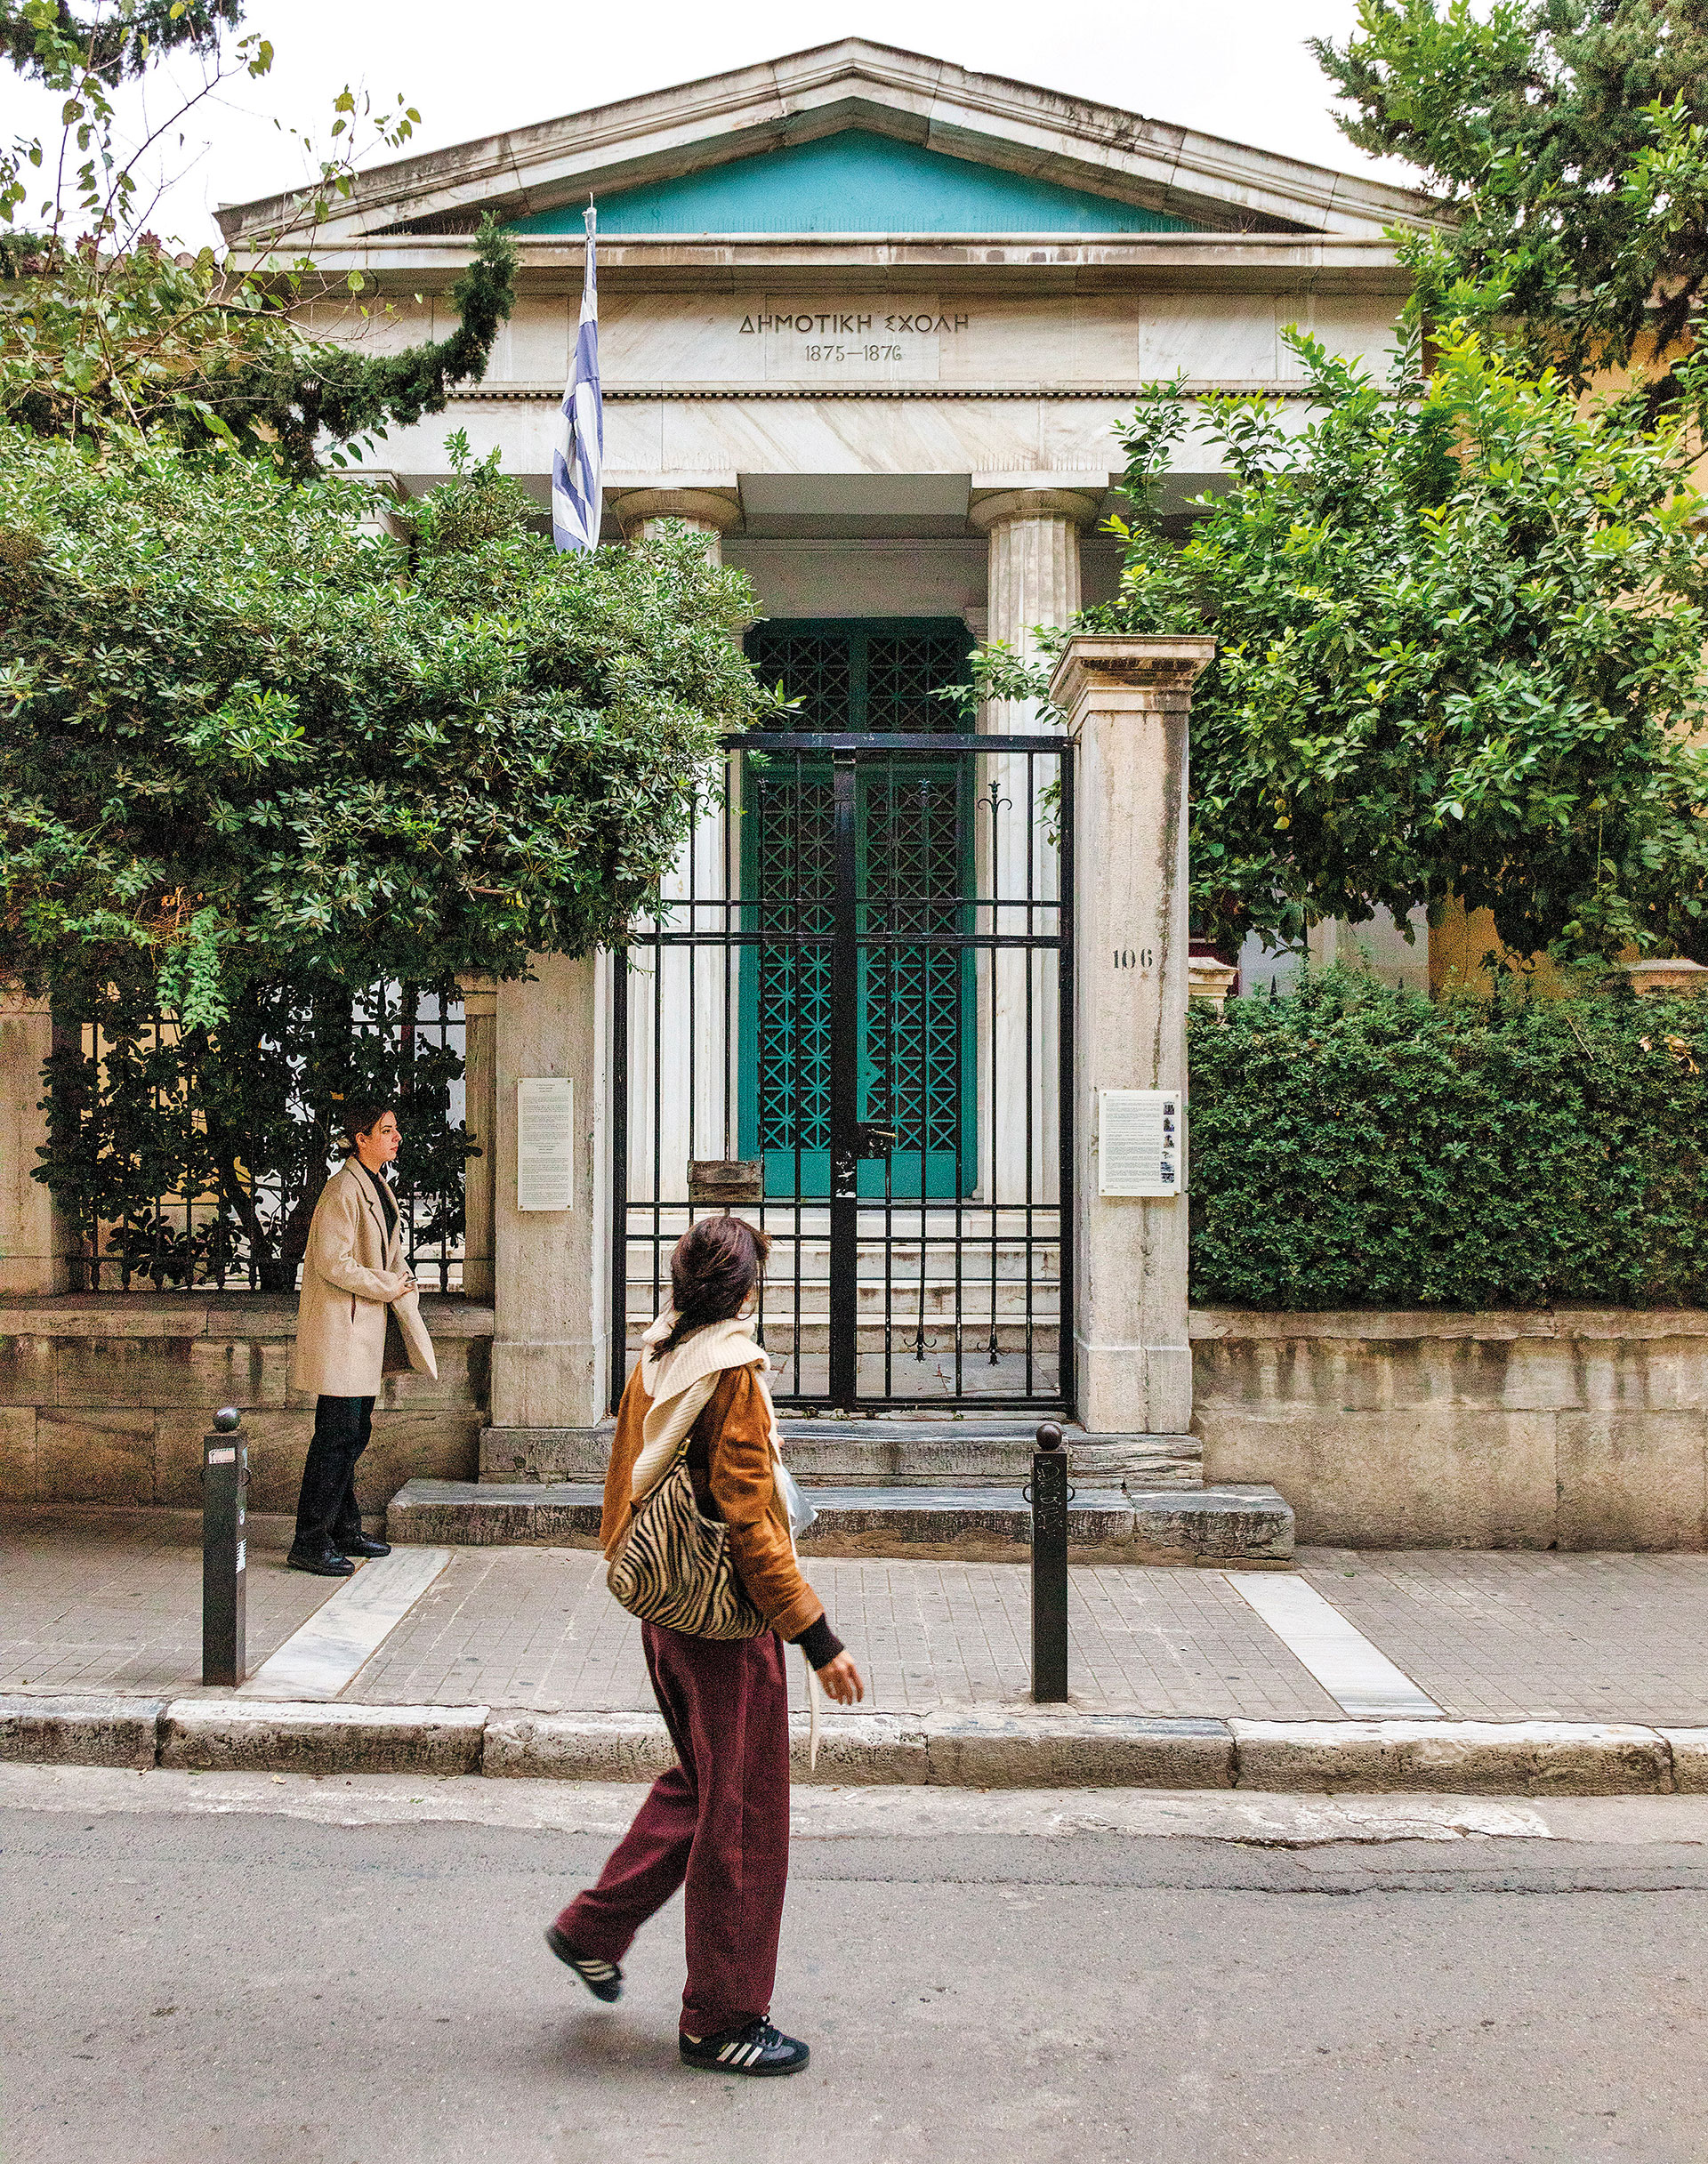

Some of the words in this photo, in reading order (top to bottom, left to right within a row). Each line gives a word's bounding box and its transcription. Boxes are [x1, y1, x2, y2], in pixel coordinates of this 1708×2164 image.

[738, 314, 872, 334] ΔΗΜΟΤΙΚΗ
[884, 314, 970, 334] ΣΧΟΛΗ
[1112, 948, 1153, 969] 106
